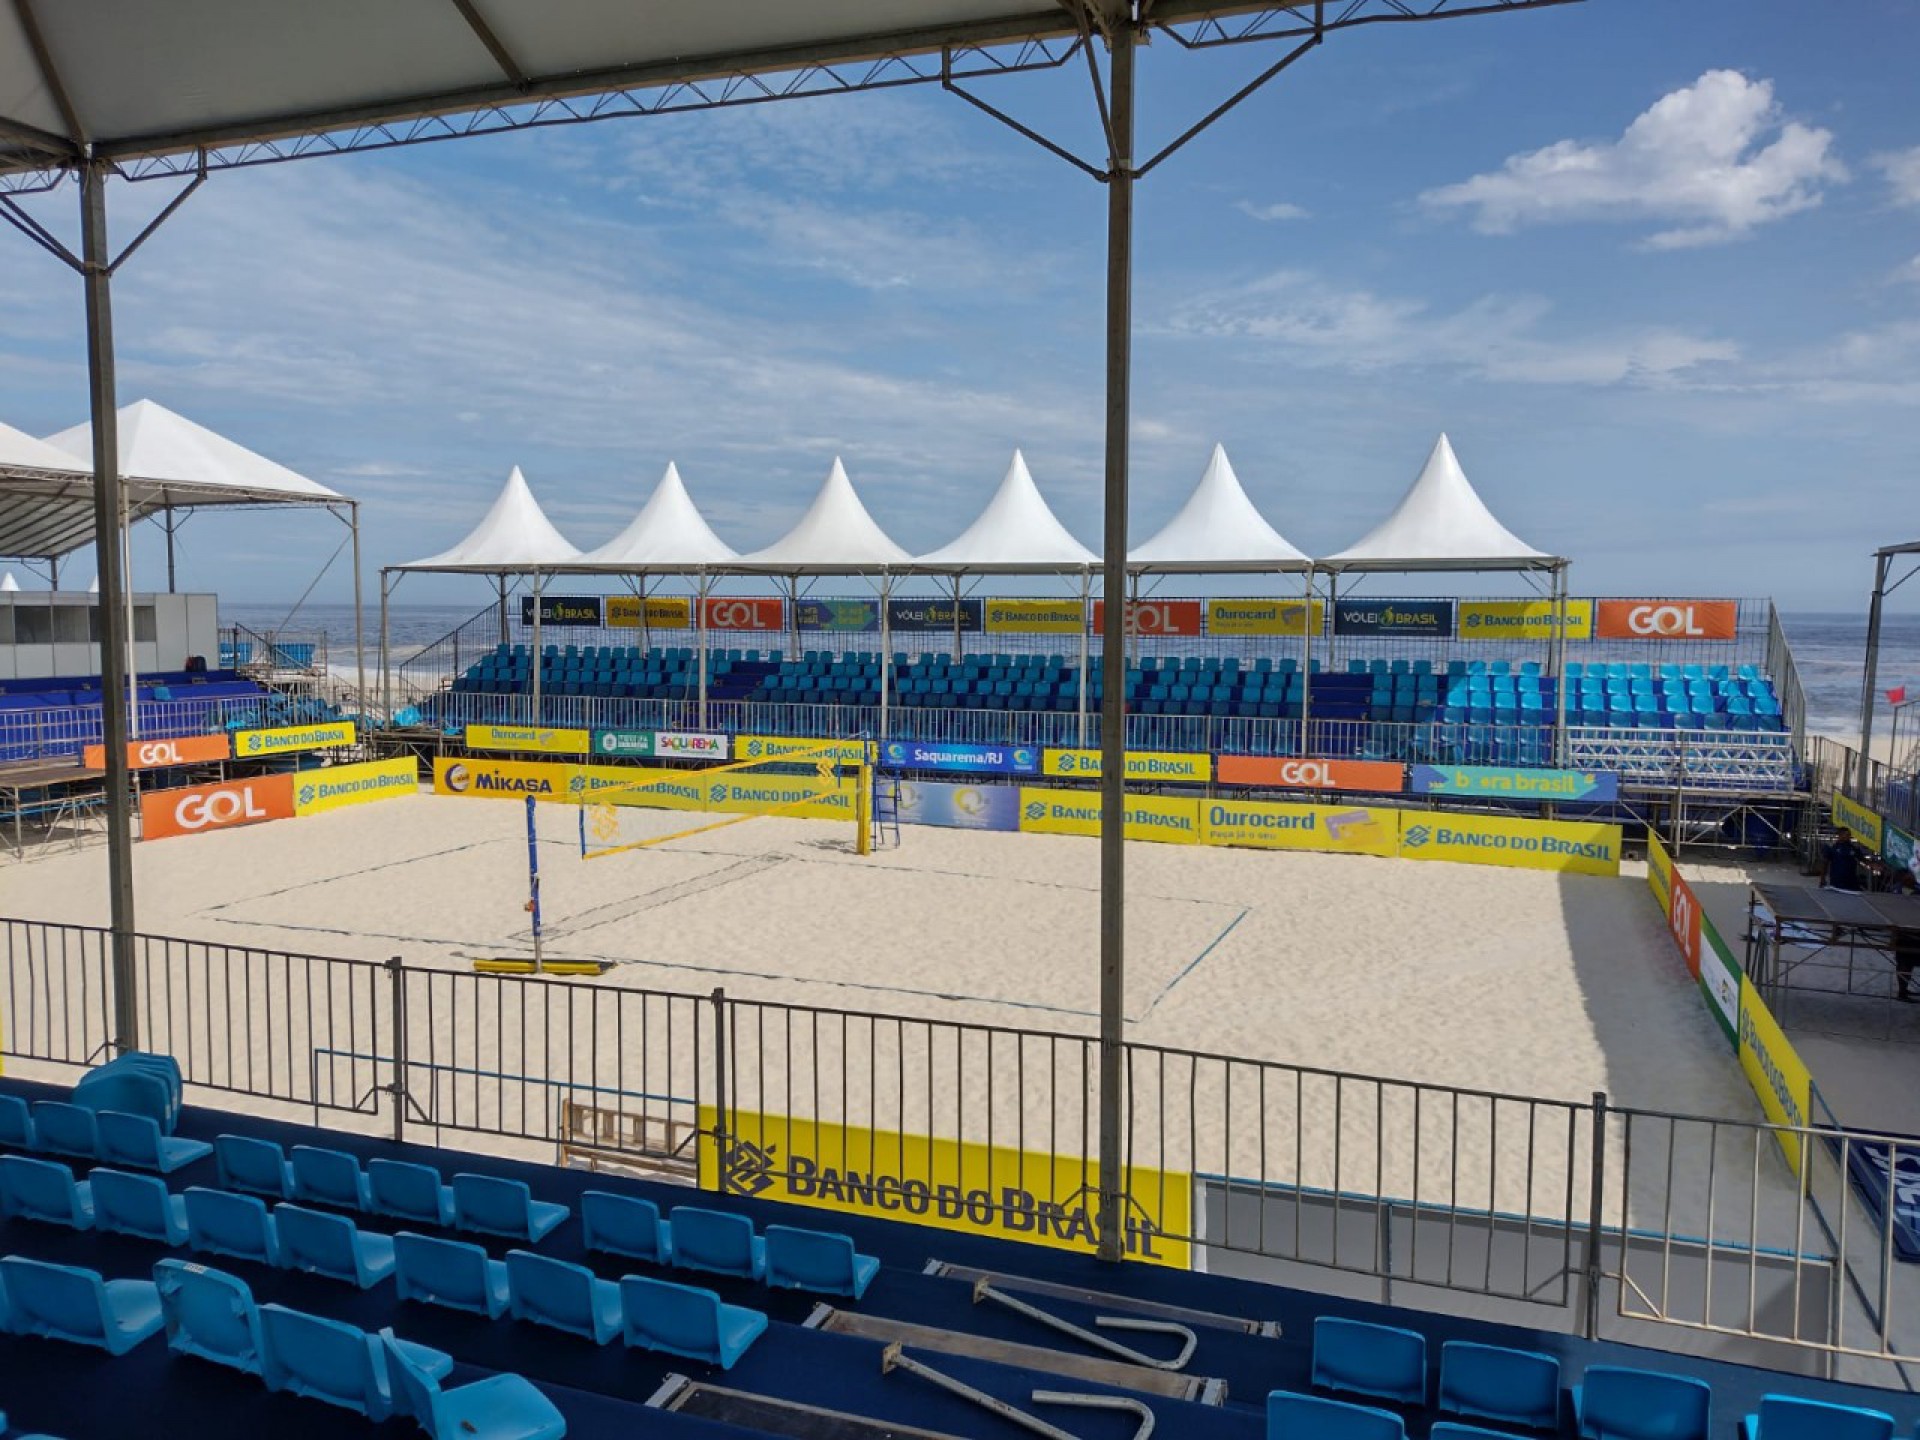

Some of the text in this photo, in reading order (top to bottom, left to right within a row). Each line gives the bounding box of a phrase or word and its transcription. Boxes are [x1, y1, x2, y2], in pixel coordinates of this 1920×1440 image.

[712, 602, 766, 628] GOL
[1004, 611, 1037, 622] BANCO
[1051, 611, 1080, 622] BRASIL
[1215, 607, 1276, 620] Ourocard
[1395, 612, 1438, 625] BRASIL
[1484, 614, 1525, 626] BANCO
[1526, 616, 1543, 626] DO
[1628, 605, 1704, 635] GOL
[264, 729, 345, 748] BANCO DO BRASIL
[139, 742, 183, 765] GOL
[914, 749, 1003, 765] Saquarema/RJ
[1128, 758, 1195, 775] DO BRASIL
[1280, 761, 1336, 786] GOL
[319, 772, 417, 798] BANCO DO BRASIL
[656, 782, 700, 800] BRASIL
[1515, 773, 1576, 793] brasil
[731, 786, 779, 802] BANCO
[782, 790, 800, 803] DO
[176, 788, 266, 828] GOL
[1209, 805, 1315, 830] Ourocard
[1136, 809, 1193, 831] BRASIL
[1436, 828, 1612, 862] BANCO DO BRASIL
[1673, 884, 1692, 958] GOL
[786, 1154, 1163, 1260] BANCO DO BRAIL
